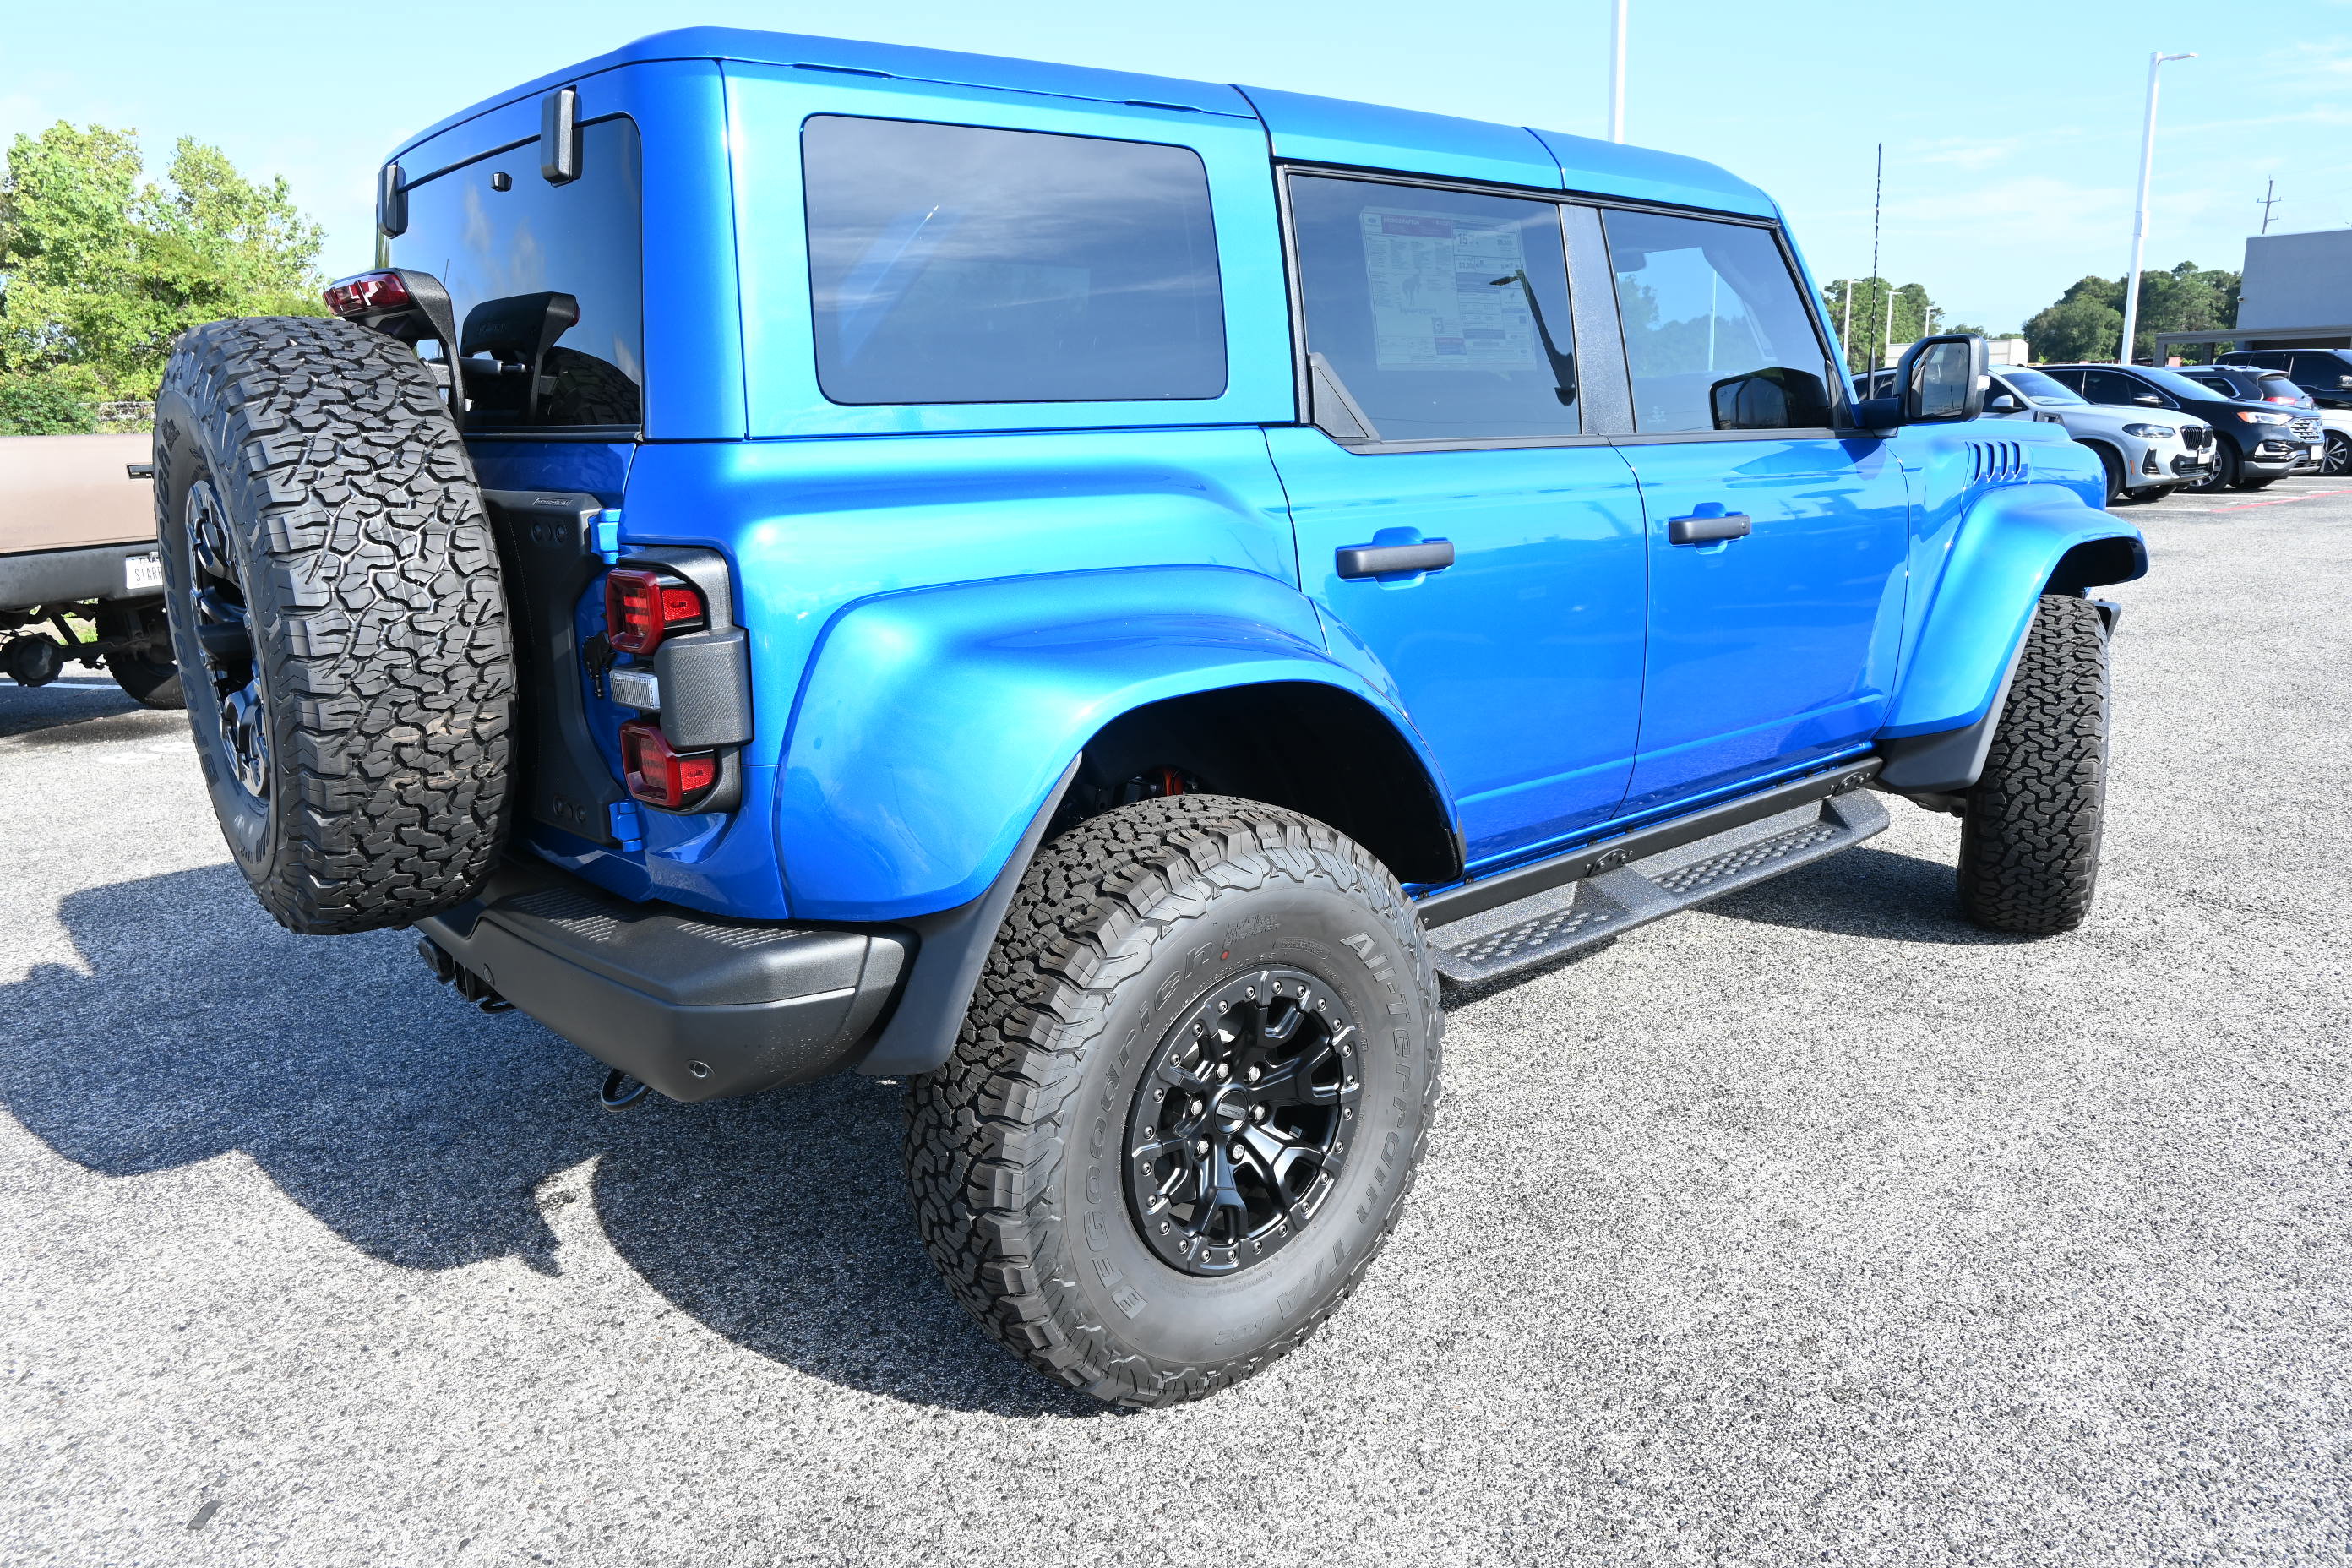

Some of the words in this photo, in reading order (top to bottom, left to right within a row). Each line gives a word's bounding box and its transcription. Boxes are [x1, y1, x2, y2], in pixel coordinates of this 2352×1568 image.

[1082, 939, 1213, 1321] BFGoodrich
[1338, 932, 1413, 1225] All-Terrain
[1277, 1237, 1352, 1320] T/A
